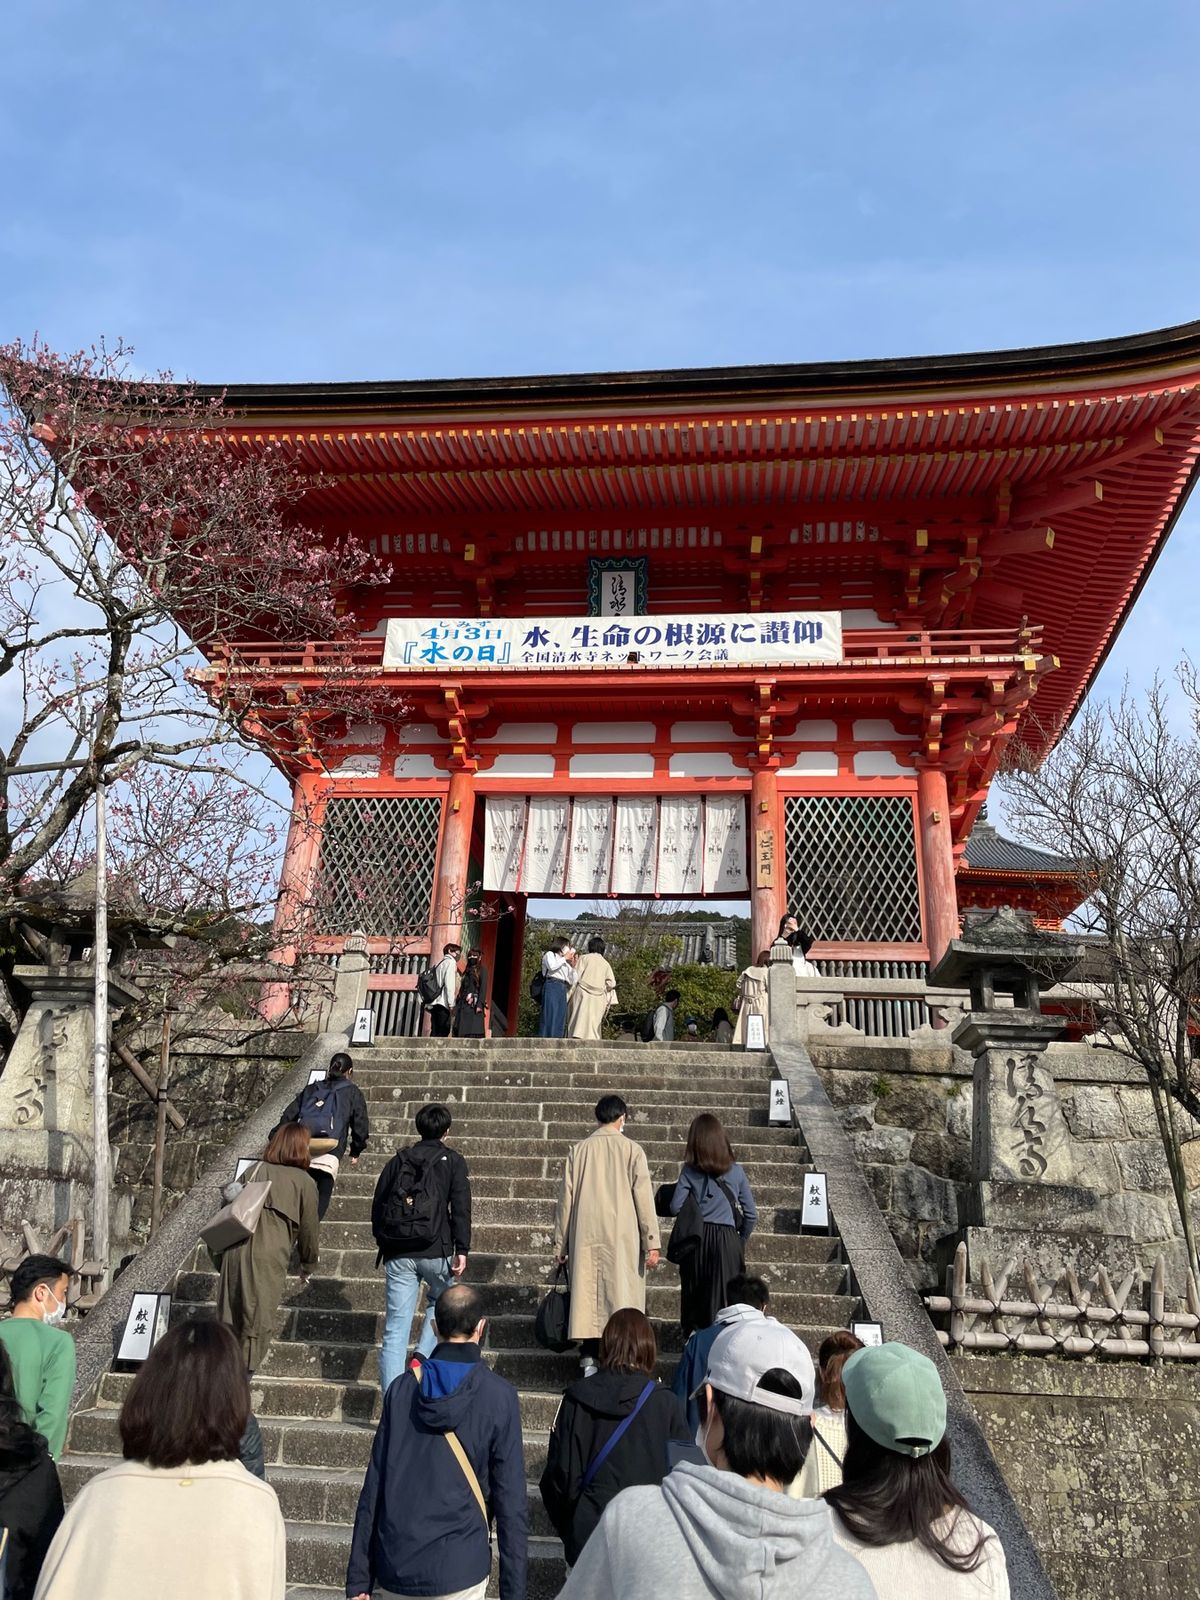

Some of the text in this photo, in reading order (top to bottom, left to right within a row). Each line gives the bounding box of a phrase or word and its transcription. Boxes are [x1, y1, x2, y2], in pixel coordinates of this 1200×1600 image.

[420, 627, 502, 640] 4月3日
[439, 620, 491, 628] しみず
[521, 619, 823, 648] 水、生命の根源に讃仰
[760, 839, 771, 875] 仁王門
